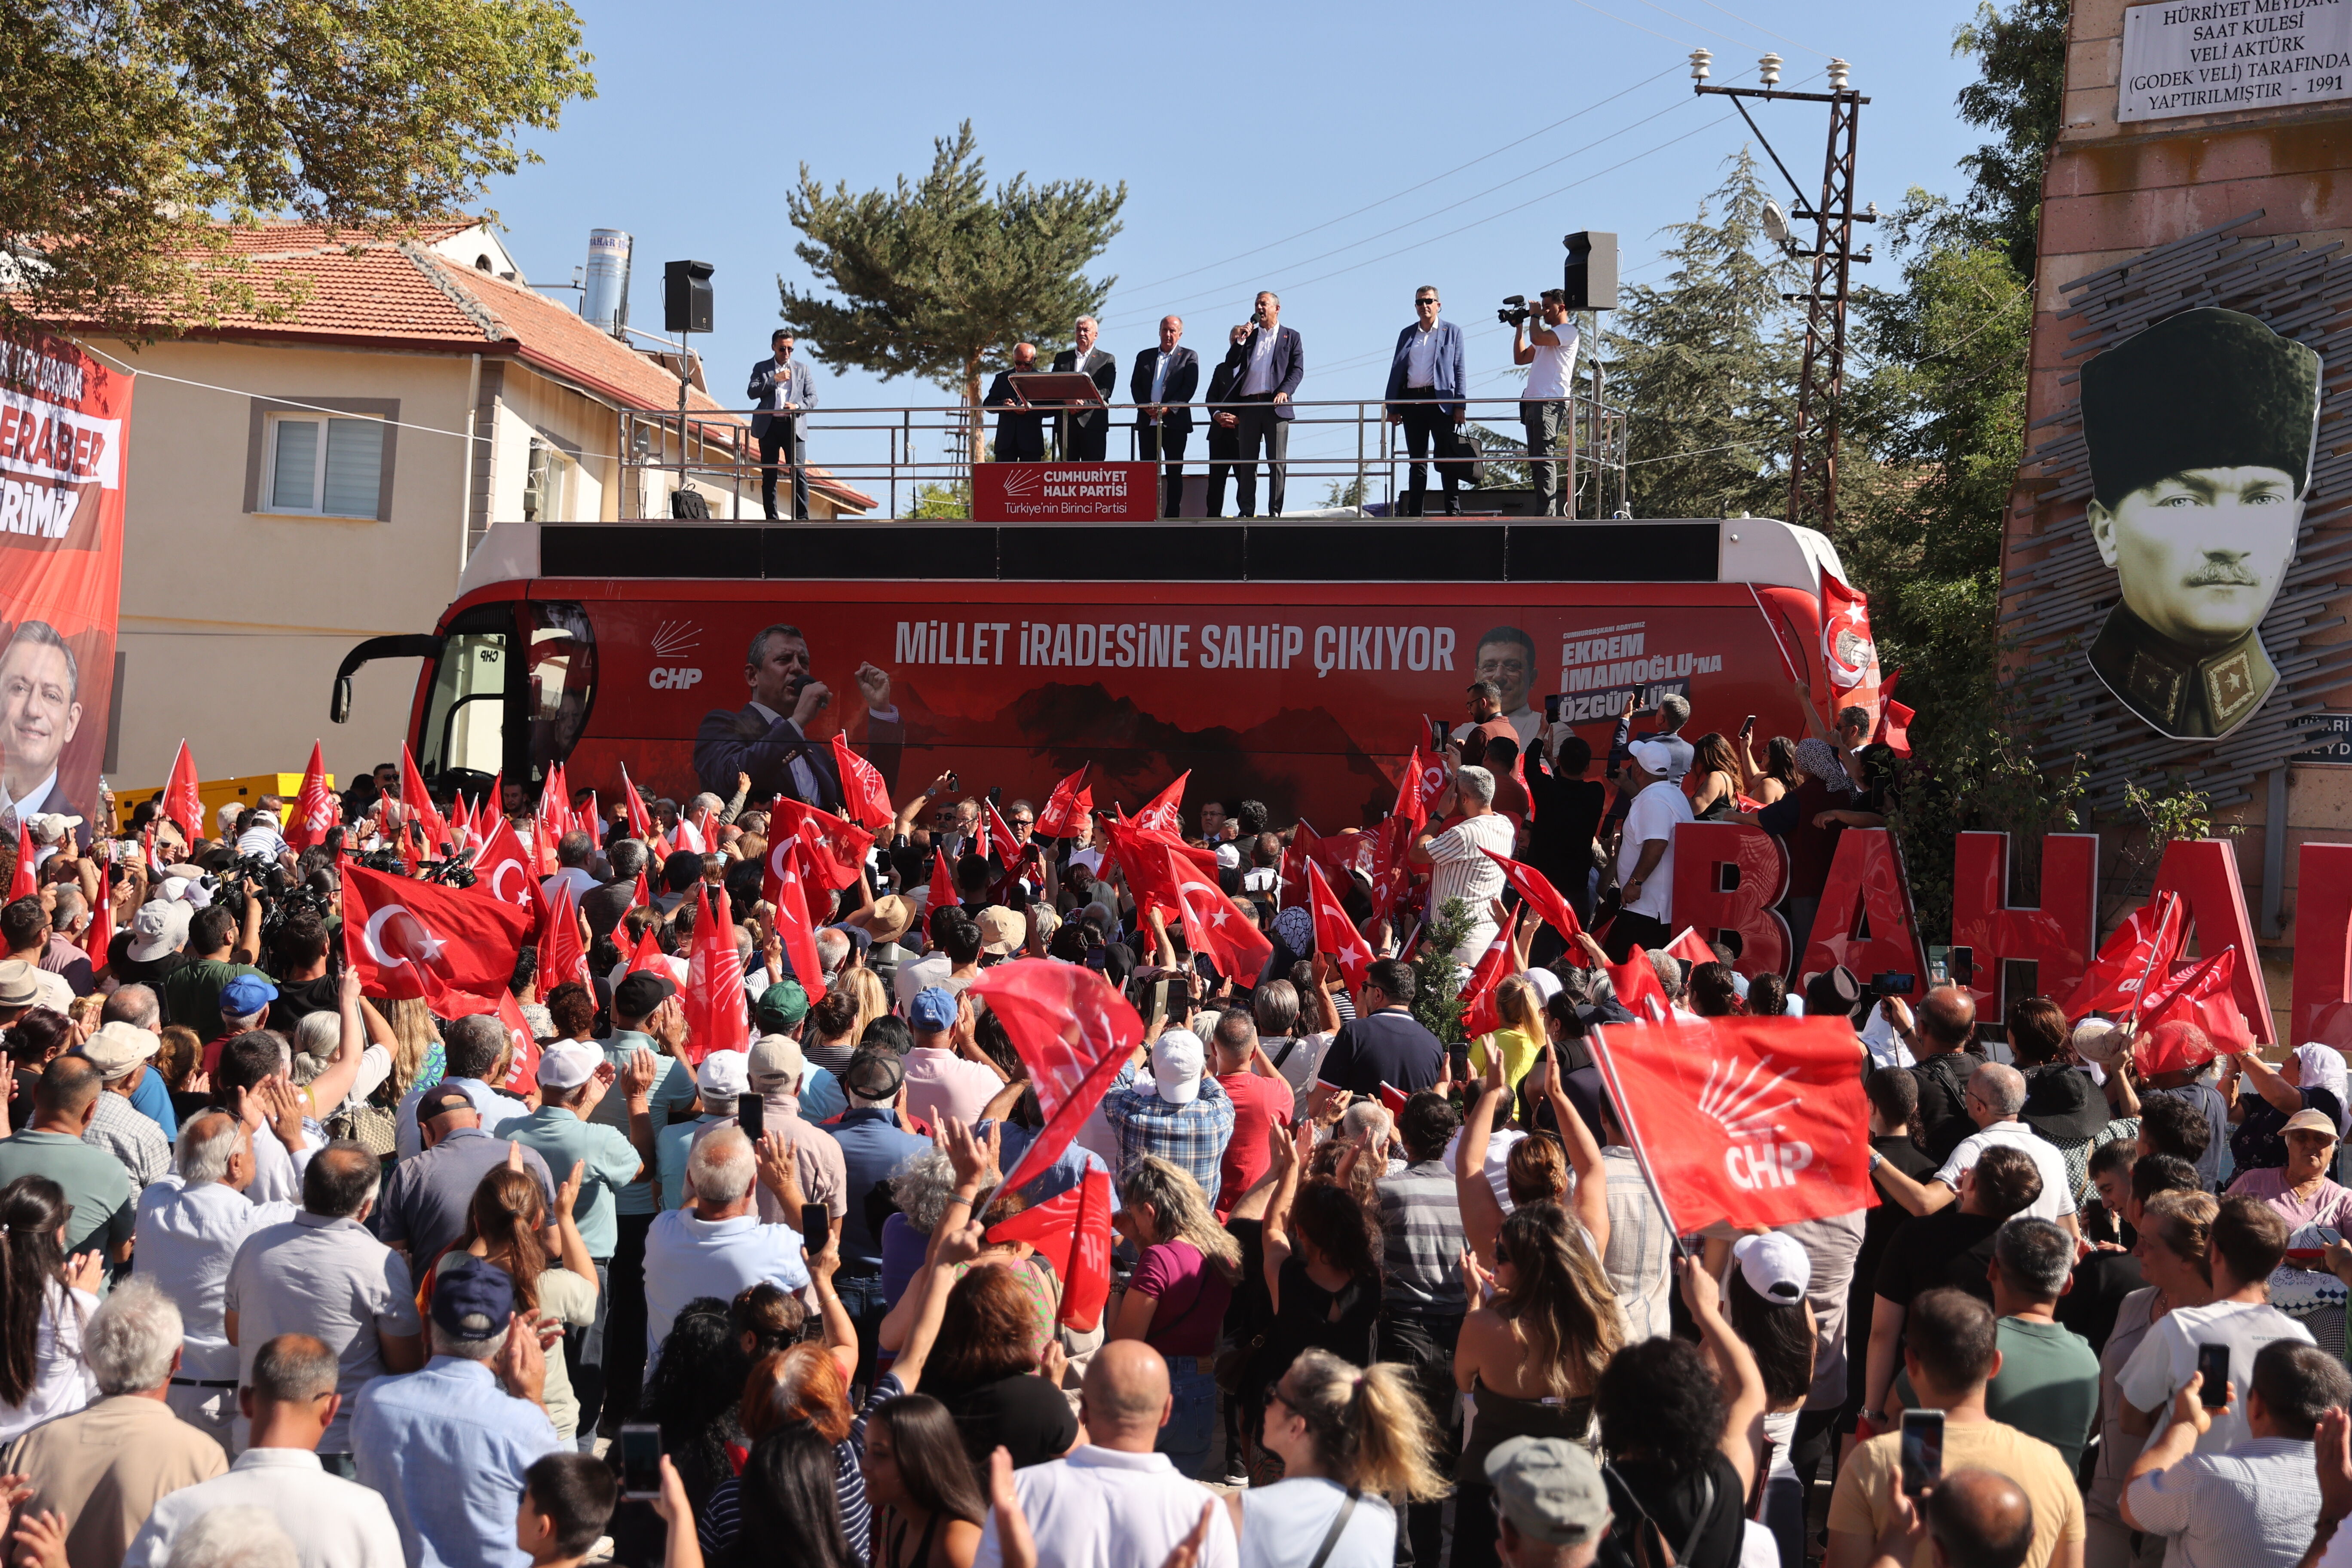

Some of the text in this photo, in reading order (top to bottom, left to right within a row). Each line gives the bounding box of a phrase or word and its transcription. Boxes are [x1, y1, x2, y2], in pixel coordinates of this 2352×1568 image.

[2163, 1, 2251, 25] HÜRRİYET
[2193, 11, 2305, 41] SAAT KULESİ
[2190, 36, 2305, 63] VELİ AKTÜRK
[2129, 52, 2352, 94] (GODEK VELİ) TARAFINDA
[2149, 82, 2282, 110] YAPTIRILMIŞTIR
[2308, 75, 2343, 93] 1991
[39, 356, 83, 402] BAŞINA
[1044, 468, 1127, 482] CUMHURİYET
[1044, 482, 1127, 496] HALK PARTİSİ
[1061, 502, 1092, 513] Birinci
[1096, 502, 1127, 513] Partisi
[1563, 622, 1645, 639] CUMHURBAŞKANI ADAYIMIZ
[1314, 625, 1455, 678] ÇIKIYOR
[1562, 633, 1645, 666] EKREM
[649, 667, 702, 689] CHP
[1724, 1141, 1813, 1190] CHP
